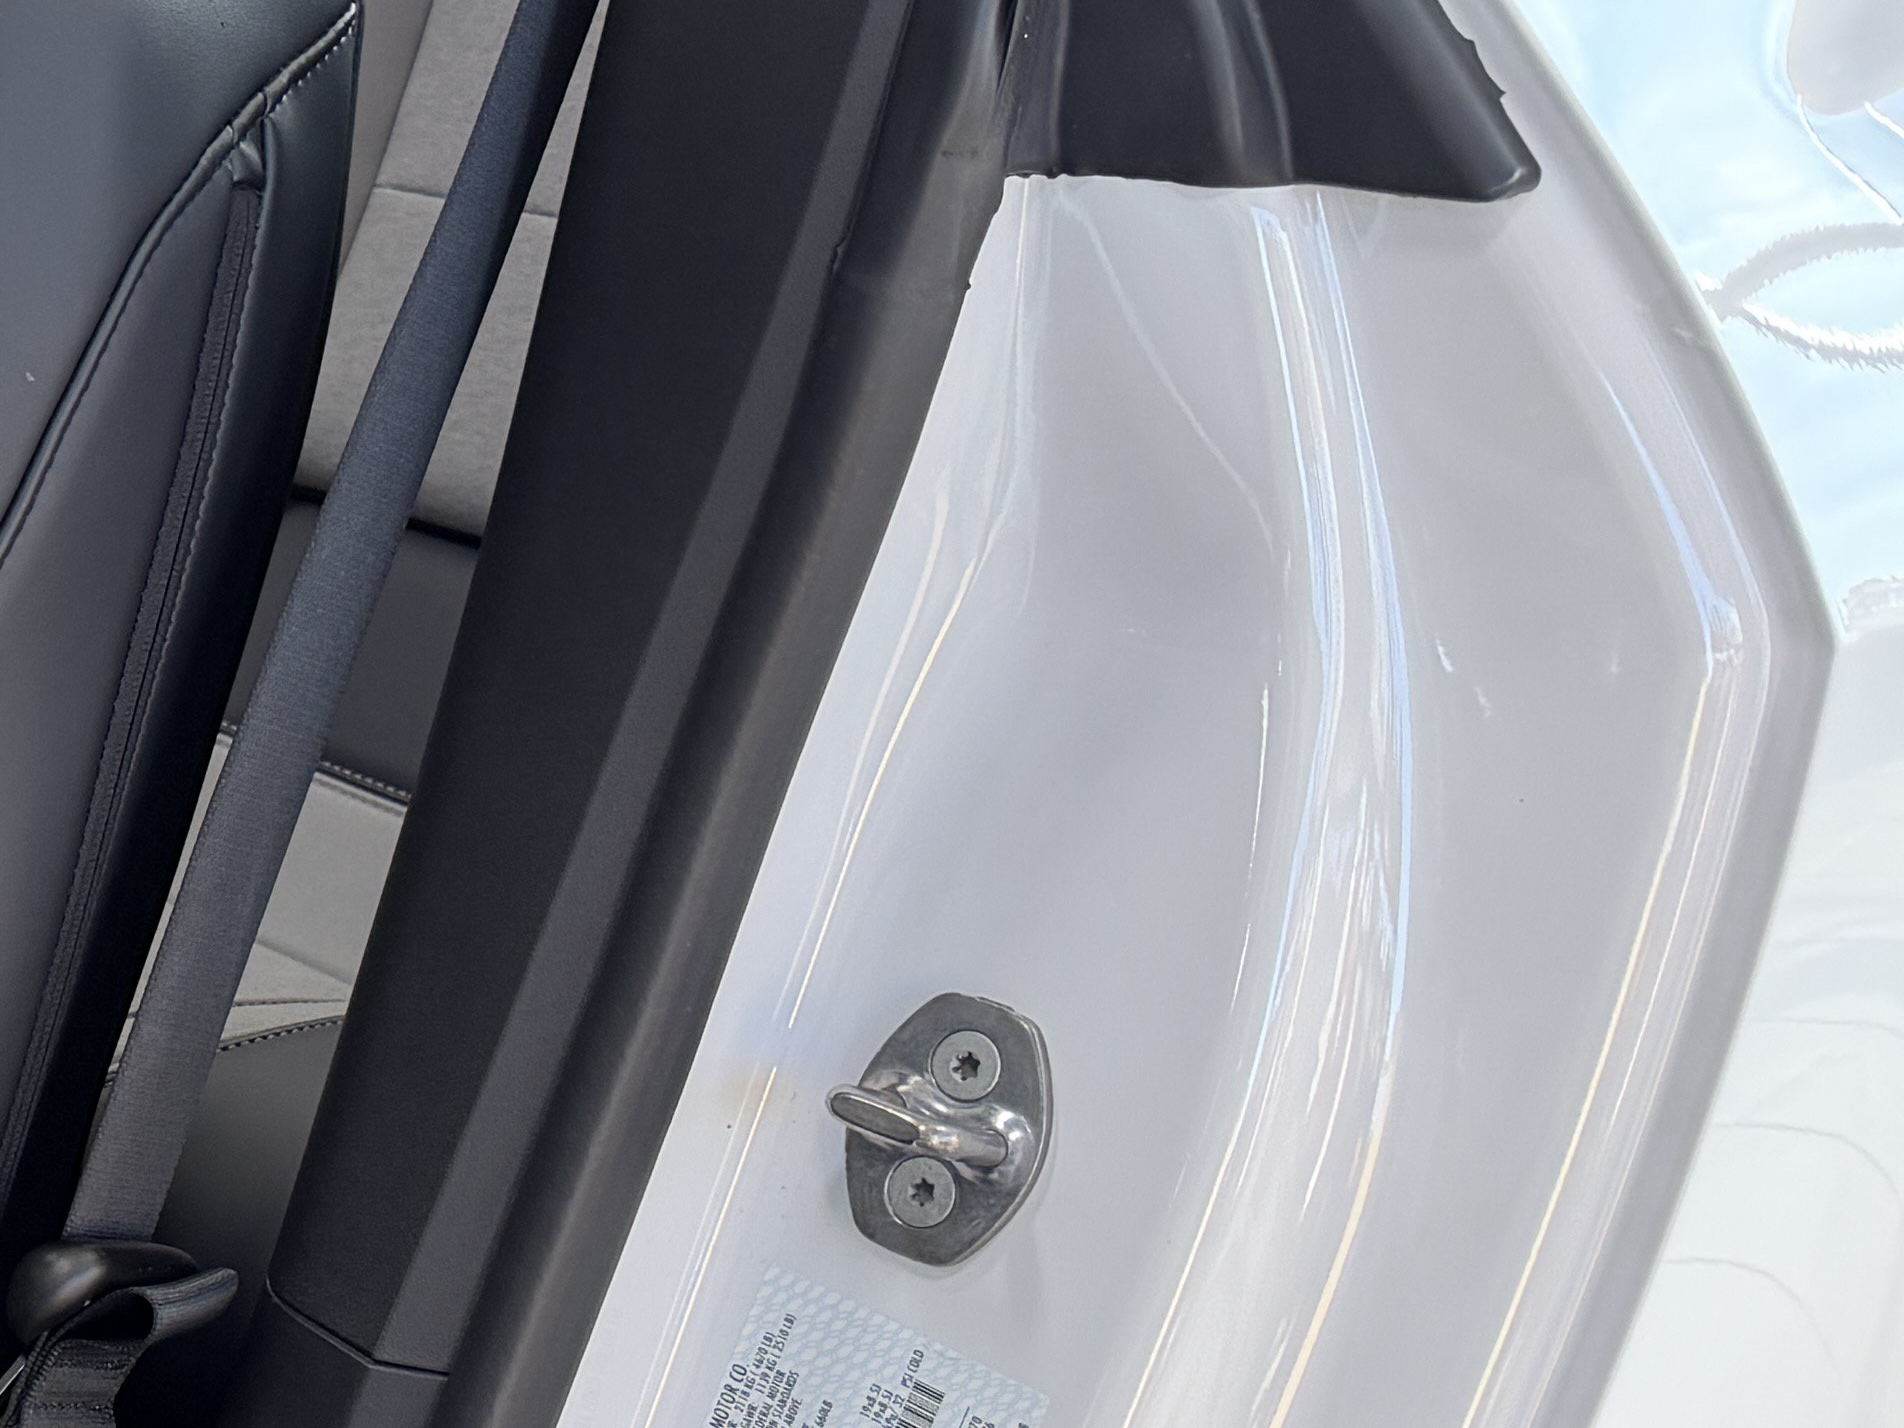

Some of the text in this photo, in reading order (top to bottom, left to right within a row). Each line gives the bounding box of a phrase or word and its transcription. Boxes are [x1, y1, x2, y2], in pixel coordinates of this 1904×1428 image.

[727, 1358, 750, 1384] CO.
[764, 1357, 777, 1372] KG
[765, 1368, 786, 1401] MOTOR
